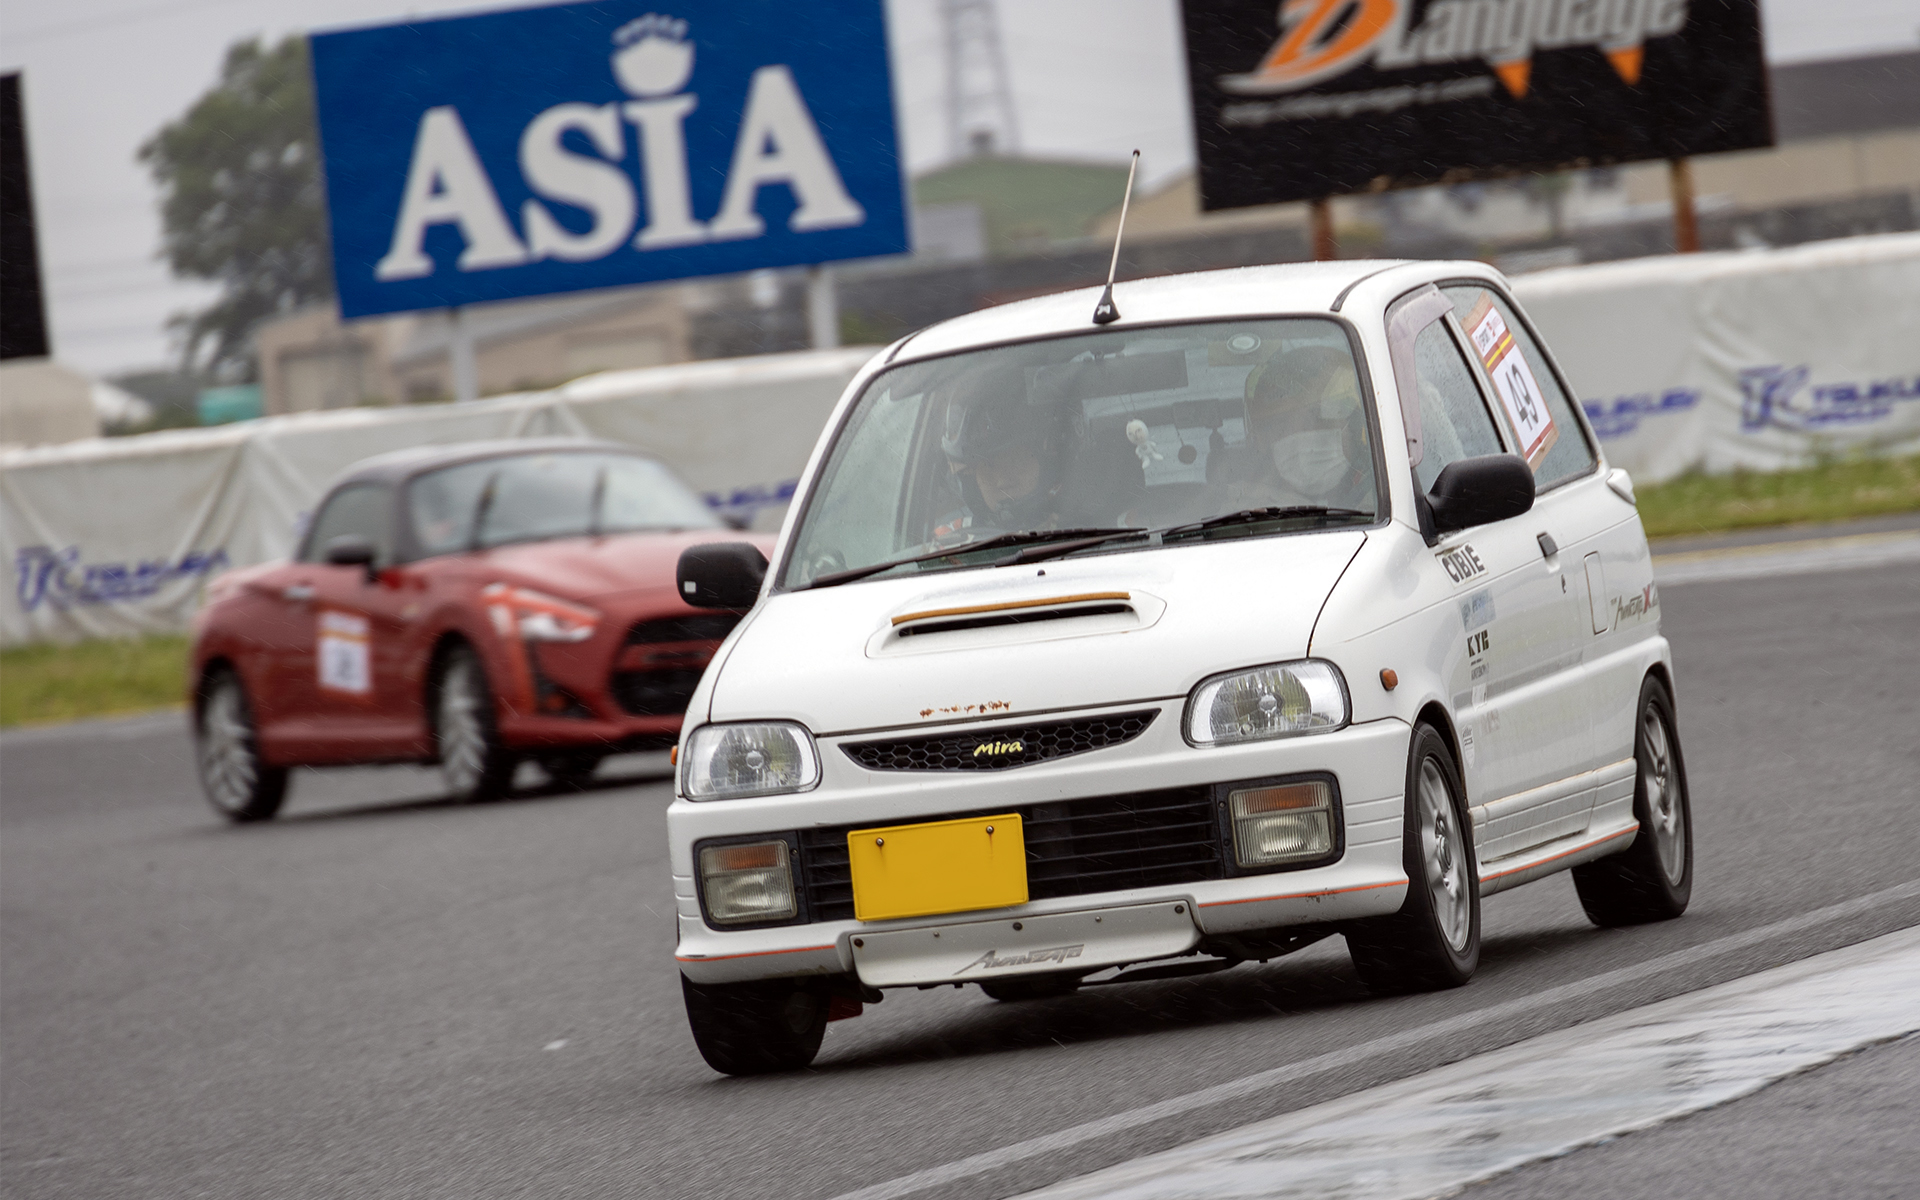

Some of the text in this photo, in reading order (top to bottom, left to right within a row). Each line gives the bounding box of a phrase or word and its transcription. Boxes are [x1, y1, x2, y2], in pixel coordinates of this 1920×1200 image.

[375, 64, 866, 281] ASIA
[1504, 362, 1540, 432] 49
[1441, 543, 1486, 583] CIBIE
[1466, 629, 1490, 657] KYB
[973, 740, 1024, 757] Mira
